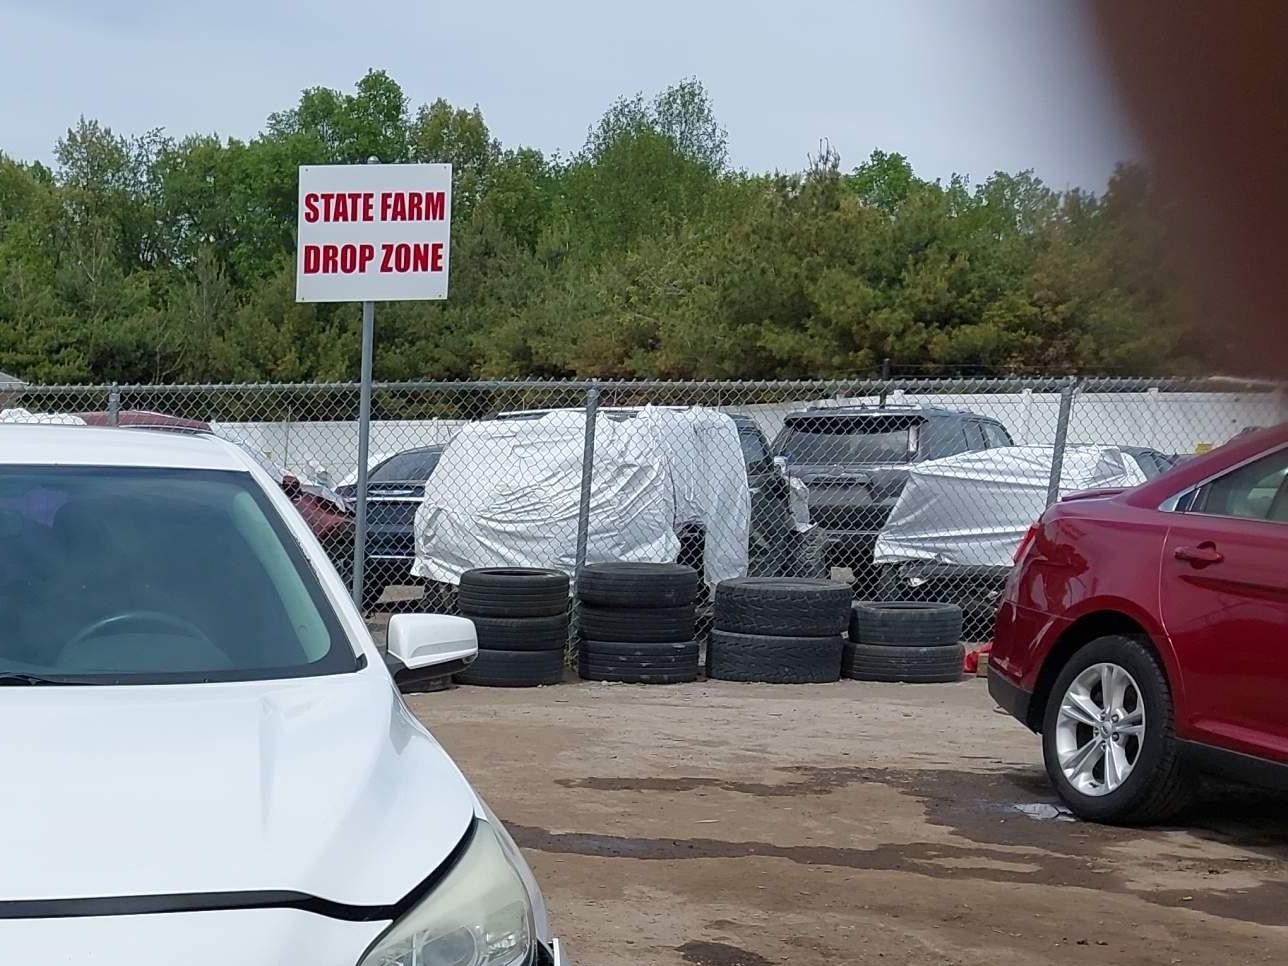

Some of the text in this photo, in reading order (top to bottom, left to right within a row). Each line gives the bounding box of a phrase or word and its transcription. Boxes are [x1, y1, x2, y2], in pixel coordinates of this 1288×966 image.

[304, 191, 446, 224] STATE FARM
[303, 243, 444, 274] DROP ZONE
